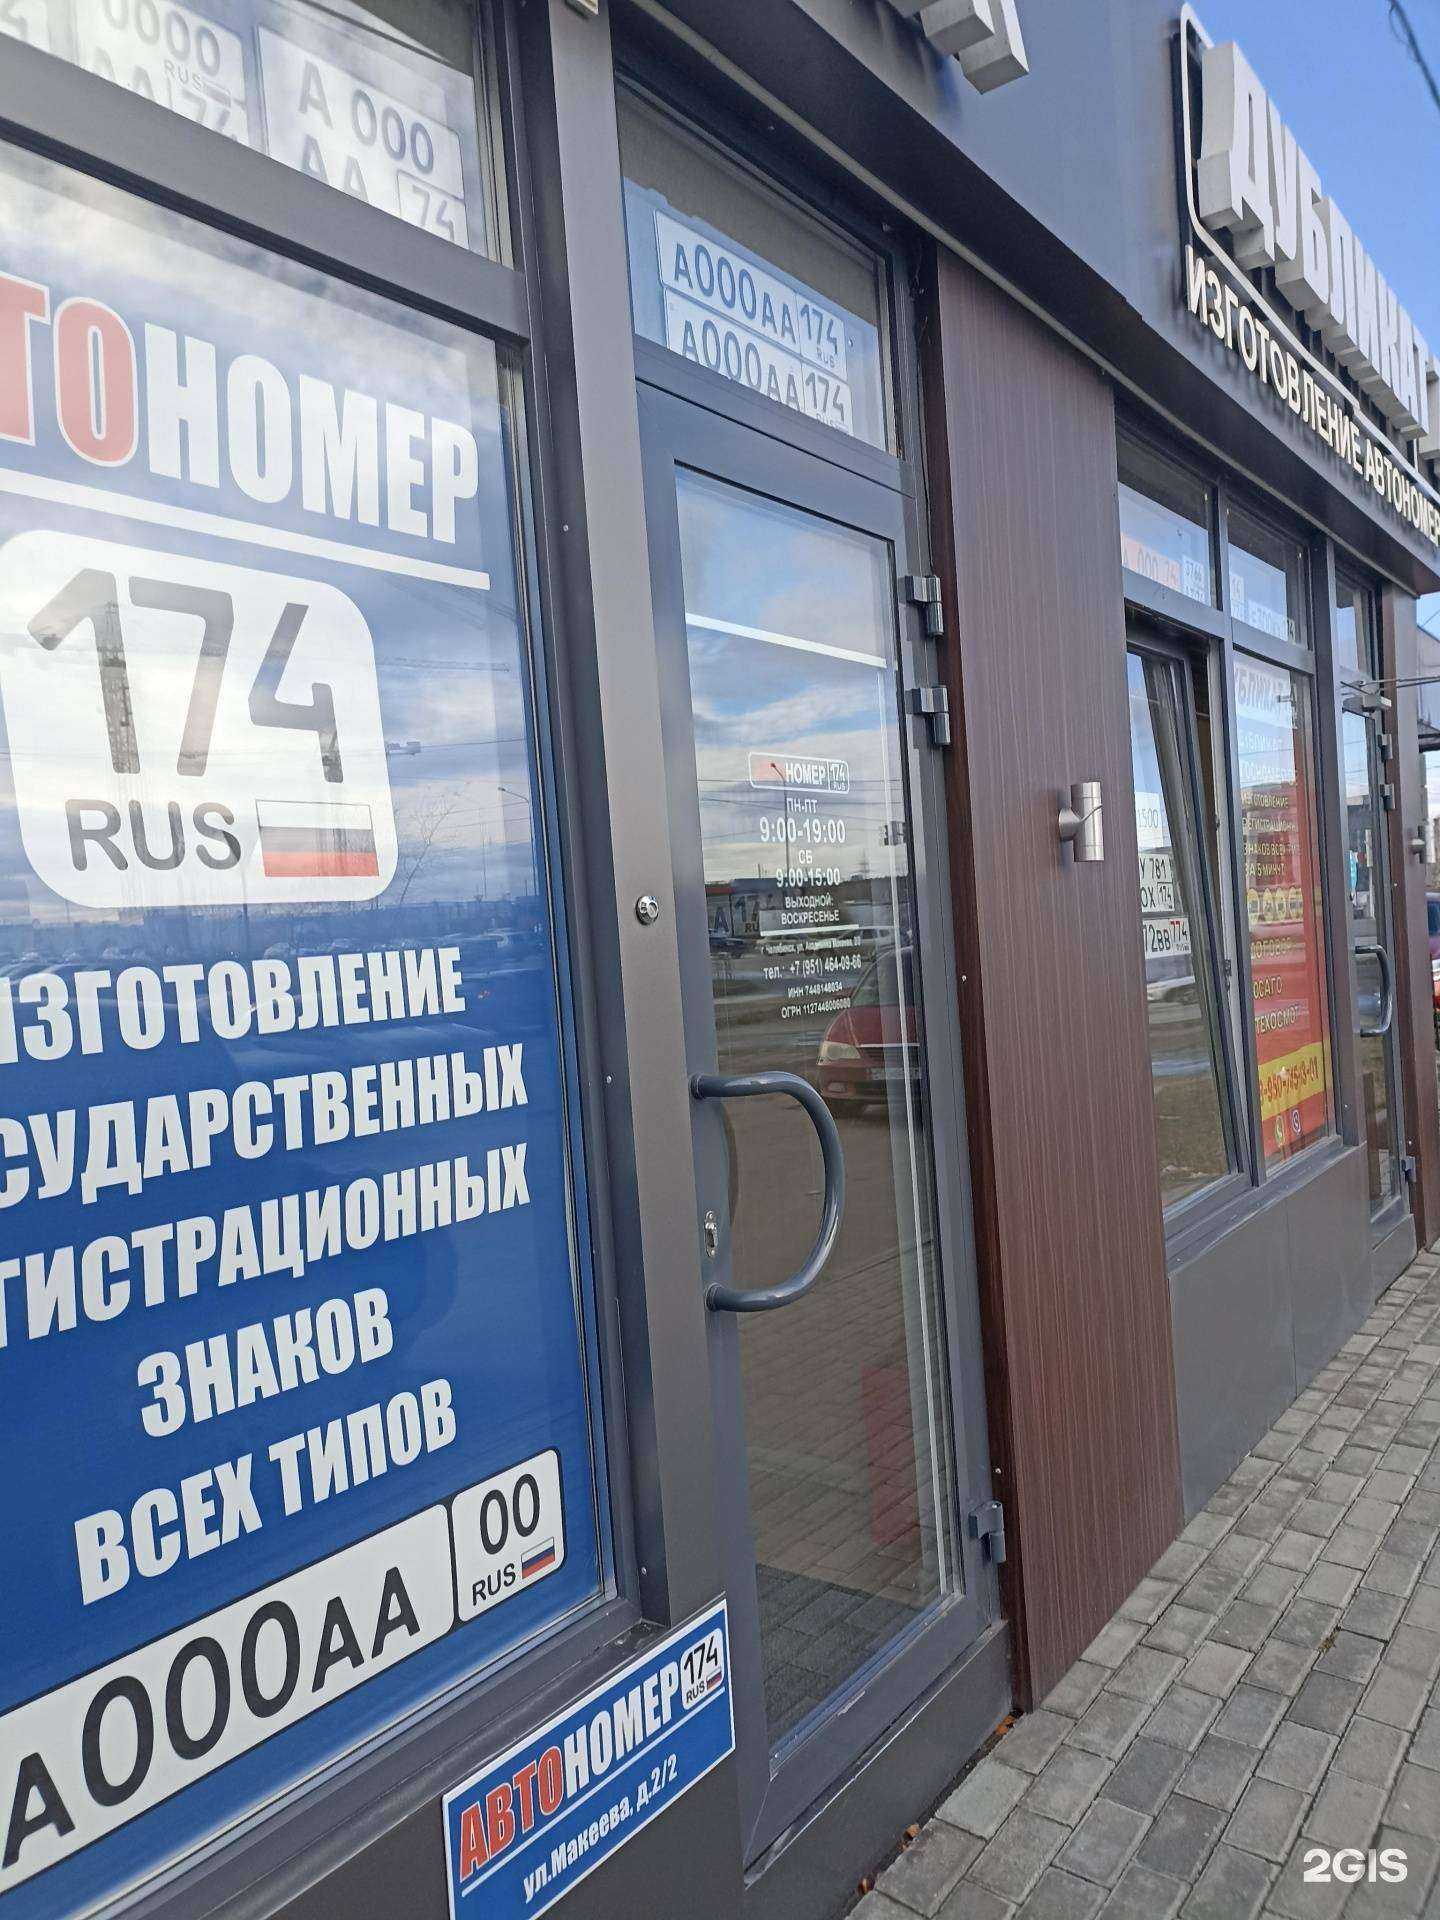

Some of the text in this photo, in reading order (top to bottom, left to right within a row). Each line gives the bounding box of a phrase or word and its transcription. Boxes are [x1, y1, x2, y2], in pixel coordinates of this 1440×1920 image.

[163, 59, 204, 91] RUS
[1187, 244, 1363, 476] ИЗГОТОВЛЕНИЕ
[28, 568, 344, 783] 174
[785, 763, 826, 785] НОМЕР
[65, 799, 242, 872] RUS
[760, 817, 846, 843] 9:00-19:00
[798, 849, 813, 864] СБ
[776, 868, 841, 888] 9:00-15:00
[781, 909, 840, 925] ВОСКРЕСЕНЬЕ
[1253, 976, 1283, 1000] ОСАГО
[781, 1004, 802, 1019] ОГРН
[137, 1287, 394, 1438] ЗНАКОВ
[74, 1378, 457, 1605] ВСЕХ ТИПОВ
[472, 1562, 517, 1606] RUS
[686, 1680, 706, 1704] RUS
[459, 1635, 720, 1884] АВТОНОМЕР 174
